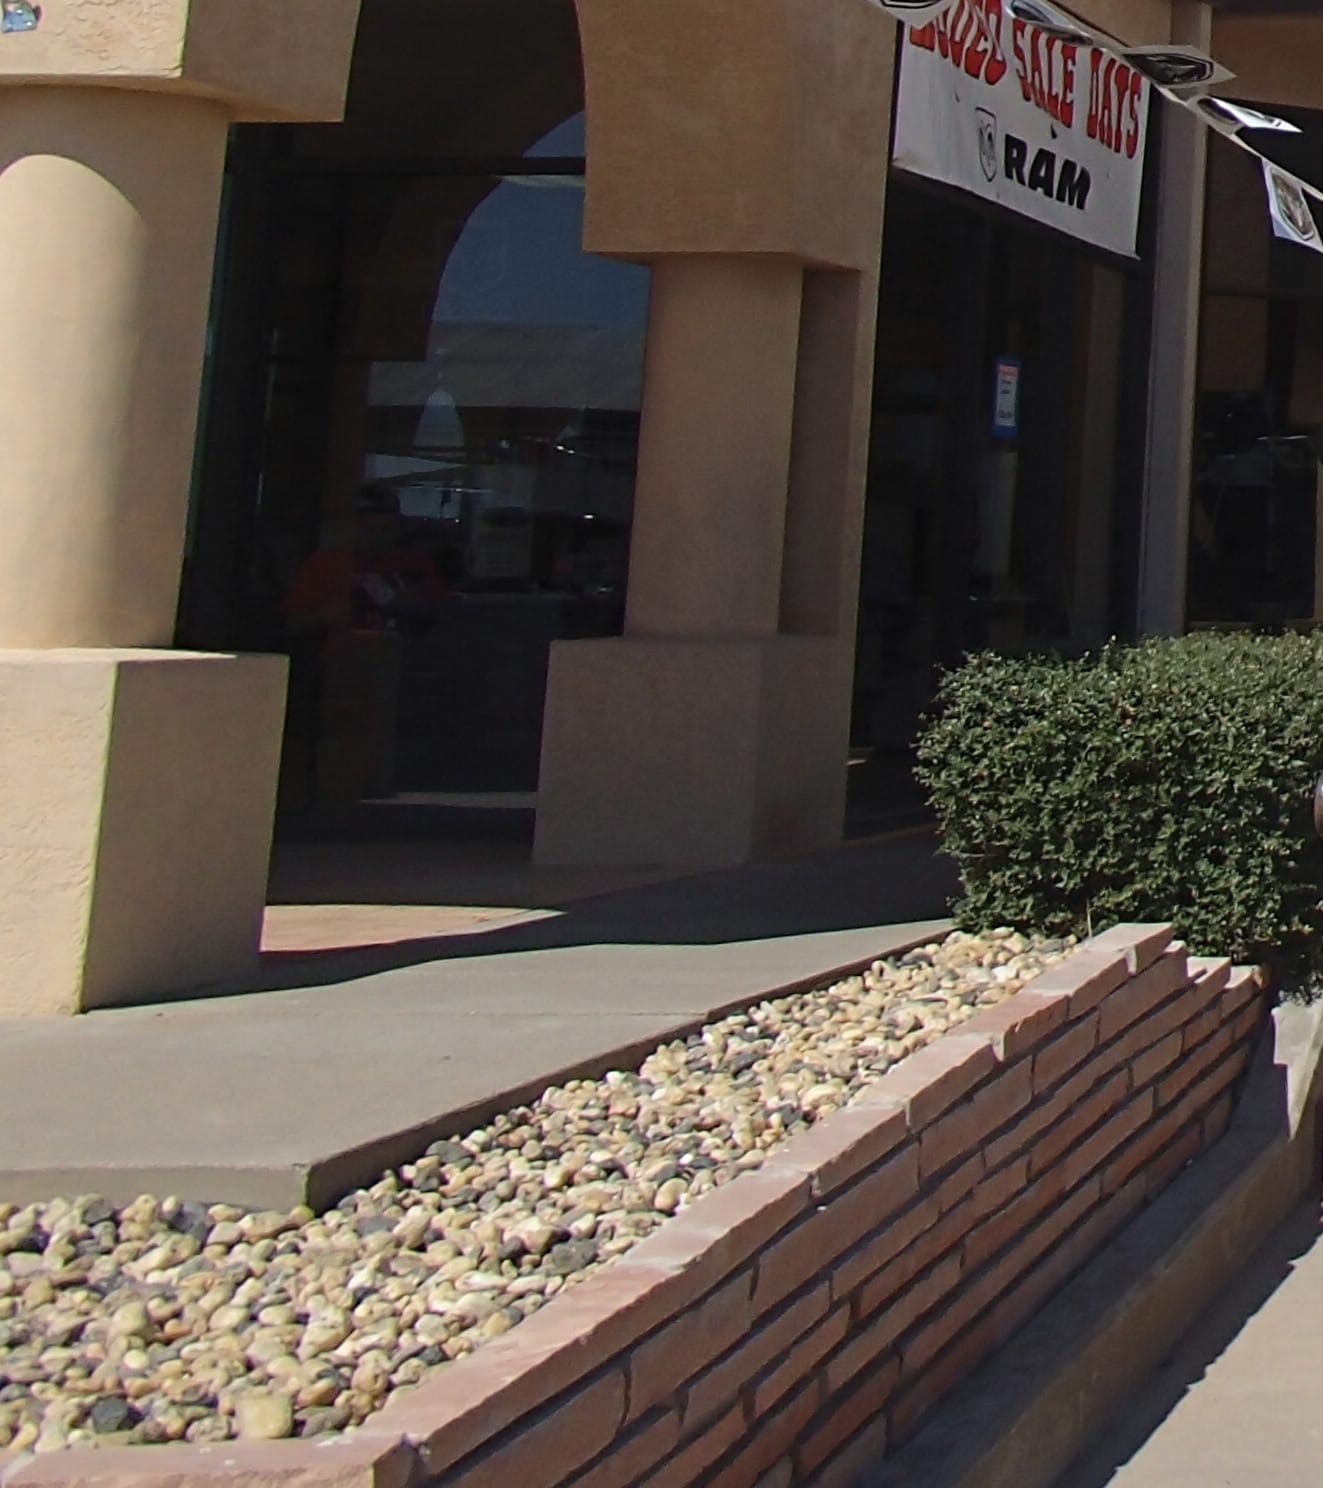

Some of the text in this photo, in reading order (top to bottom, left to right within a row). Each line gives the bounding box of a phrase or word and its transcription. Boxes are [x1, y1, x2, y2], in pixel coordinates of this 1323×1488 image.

[1012, 17, 1077, 129] SALE
[1086, 47, 1142, 159] DAYS
[1004, 133, 1092, 211] RAM
